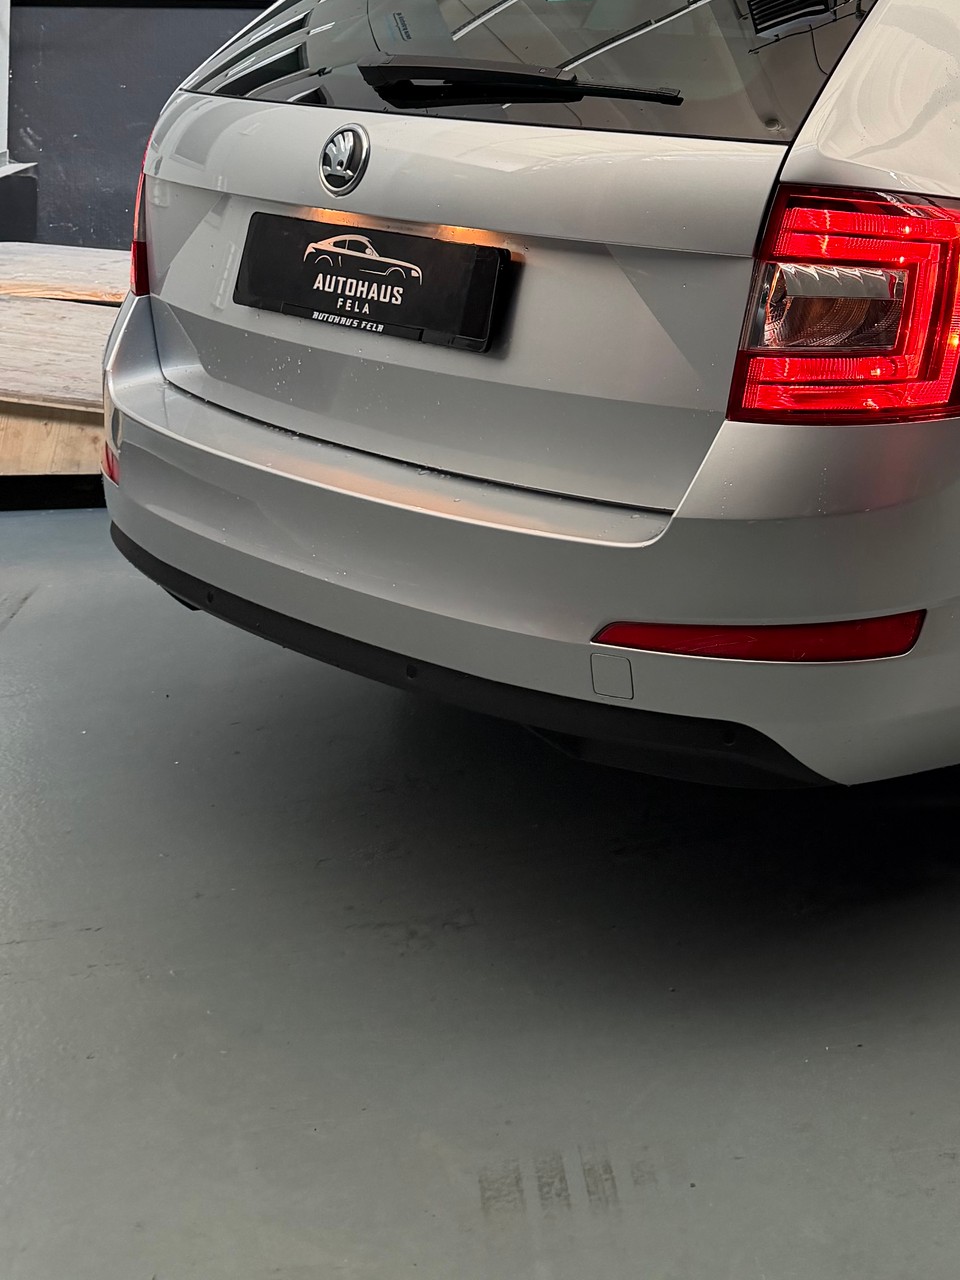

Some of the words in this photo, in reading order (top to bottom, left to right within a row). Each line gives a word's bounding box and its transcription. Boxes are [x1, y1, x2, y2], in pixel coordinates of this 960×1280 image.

[313, 272, 404, 305] AUTOHAUS
[336, 297, 370, 315] FELA
[312, 311, 360, 328] AUTOHAUS
[360, 321, 384, 333] FELA
